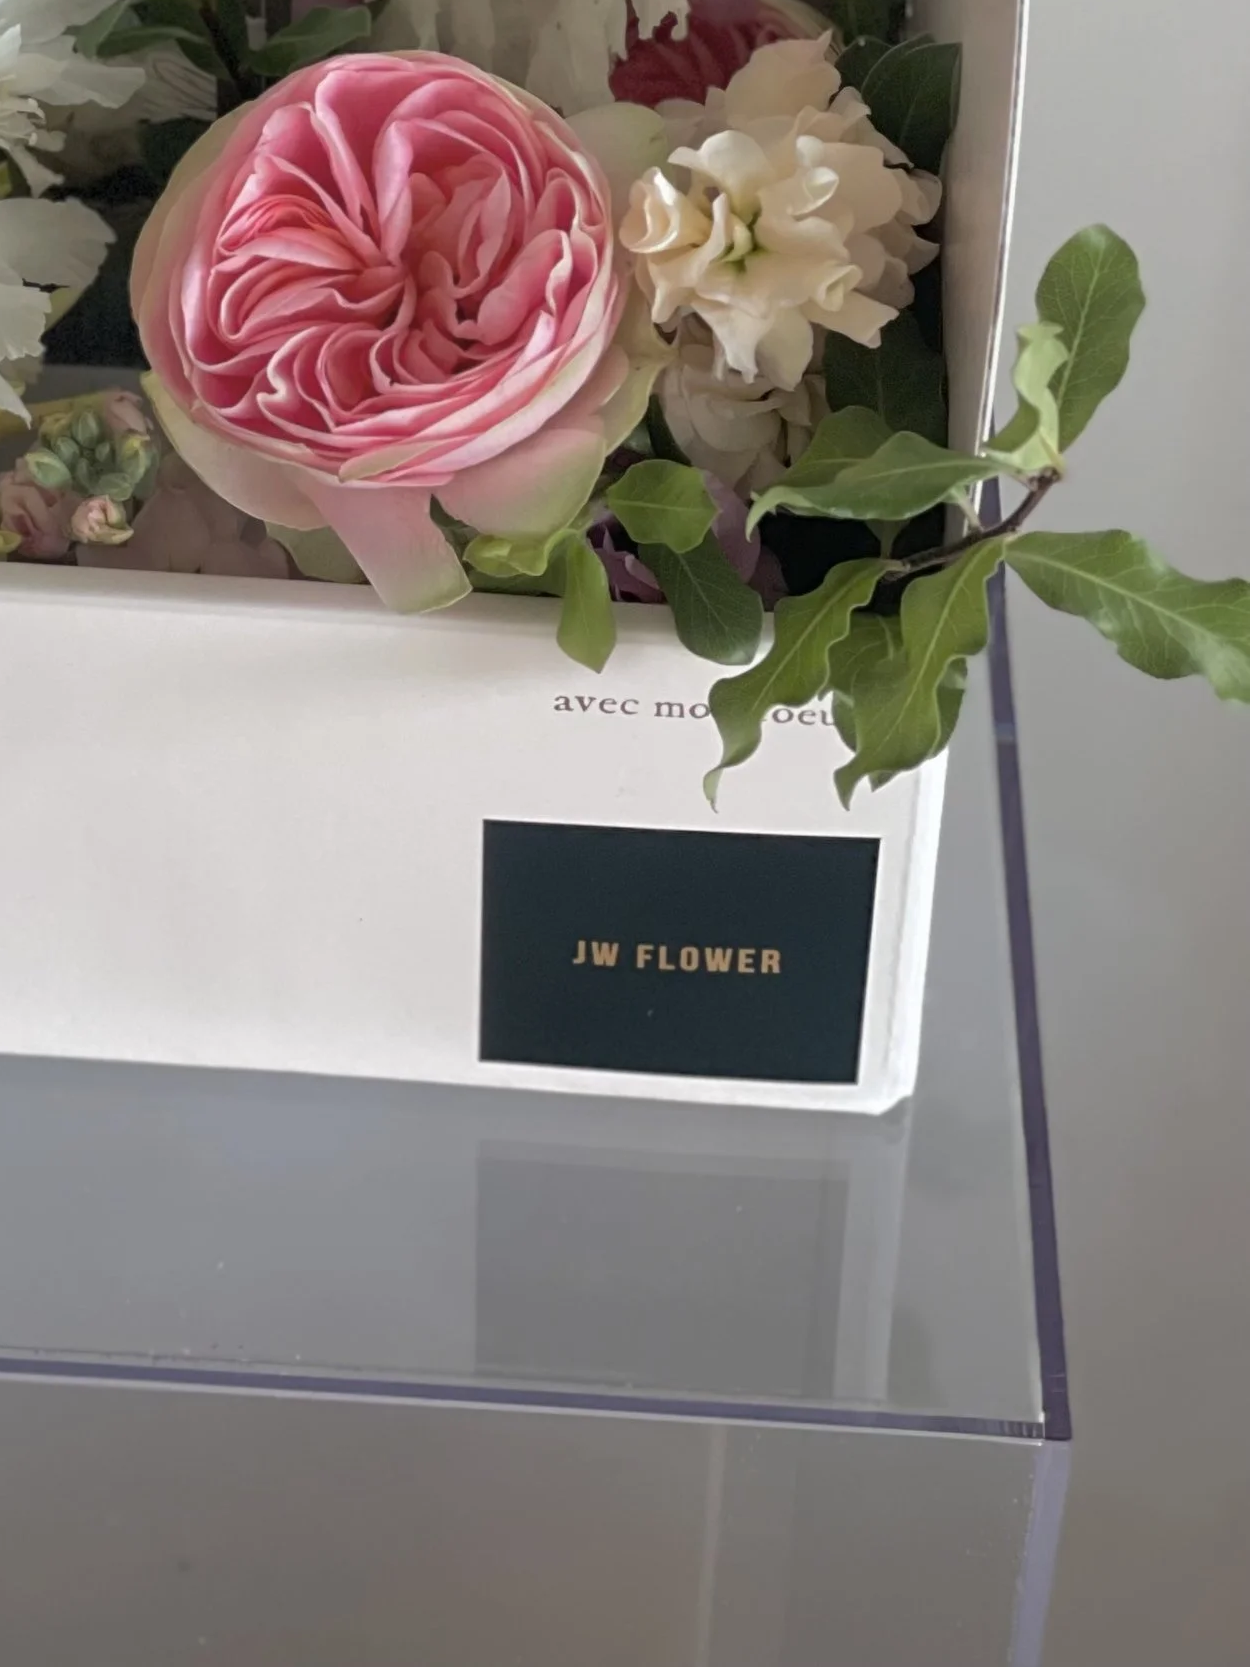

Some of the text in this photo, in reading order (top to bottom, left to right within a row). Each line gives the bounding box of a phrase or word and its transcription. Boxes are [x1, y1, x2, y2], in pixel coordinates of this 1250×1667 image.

[553, 694, 640, 716] avec
[654, 701, 712, 720] mo
[572, 939, 782, 975] JW FLOWER
